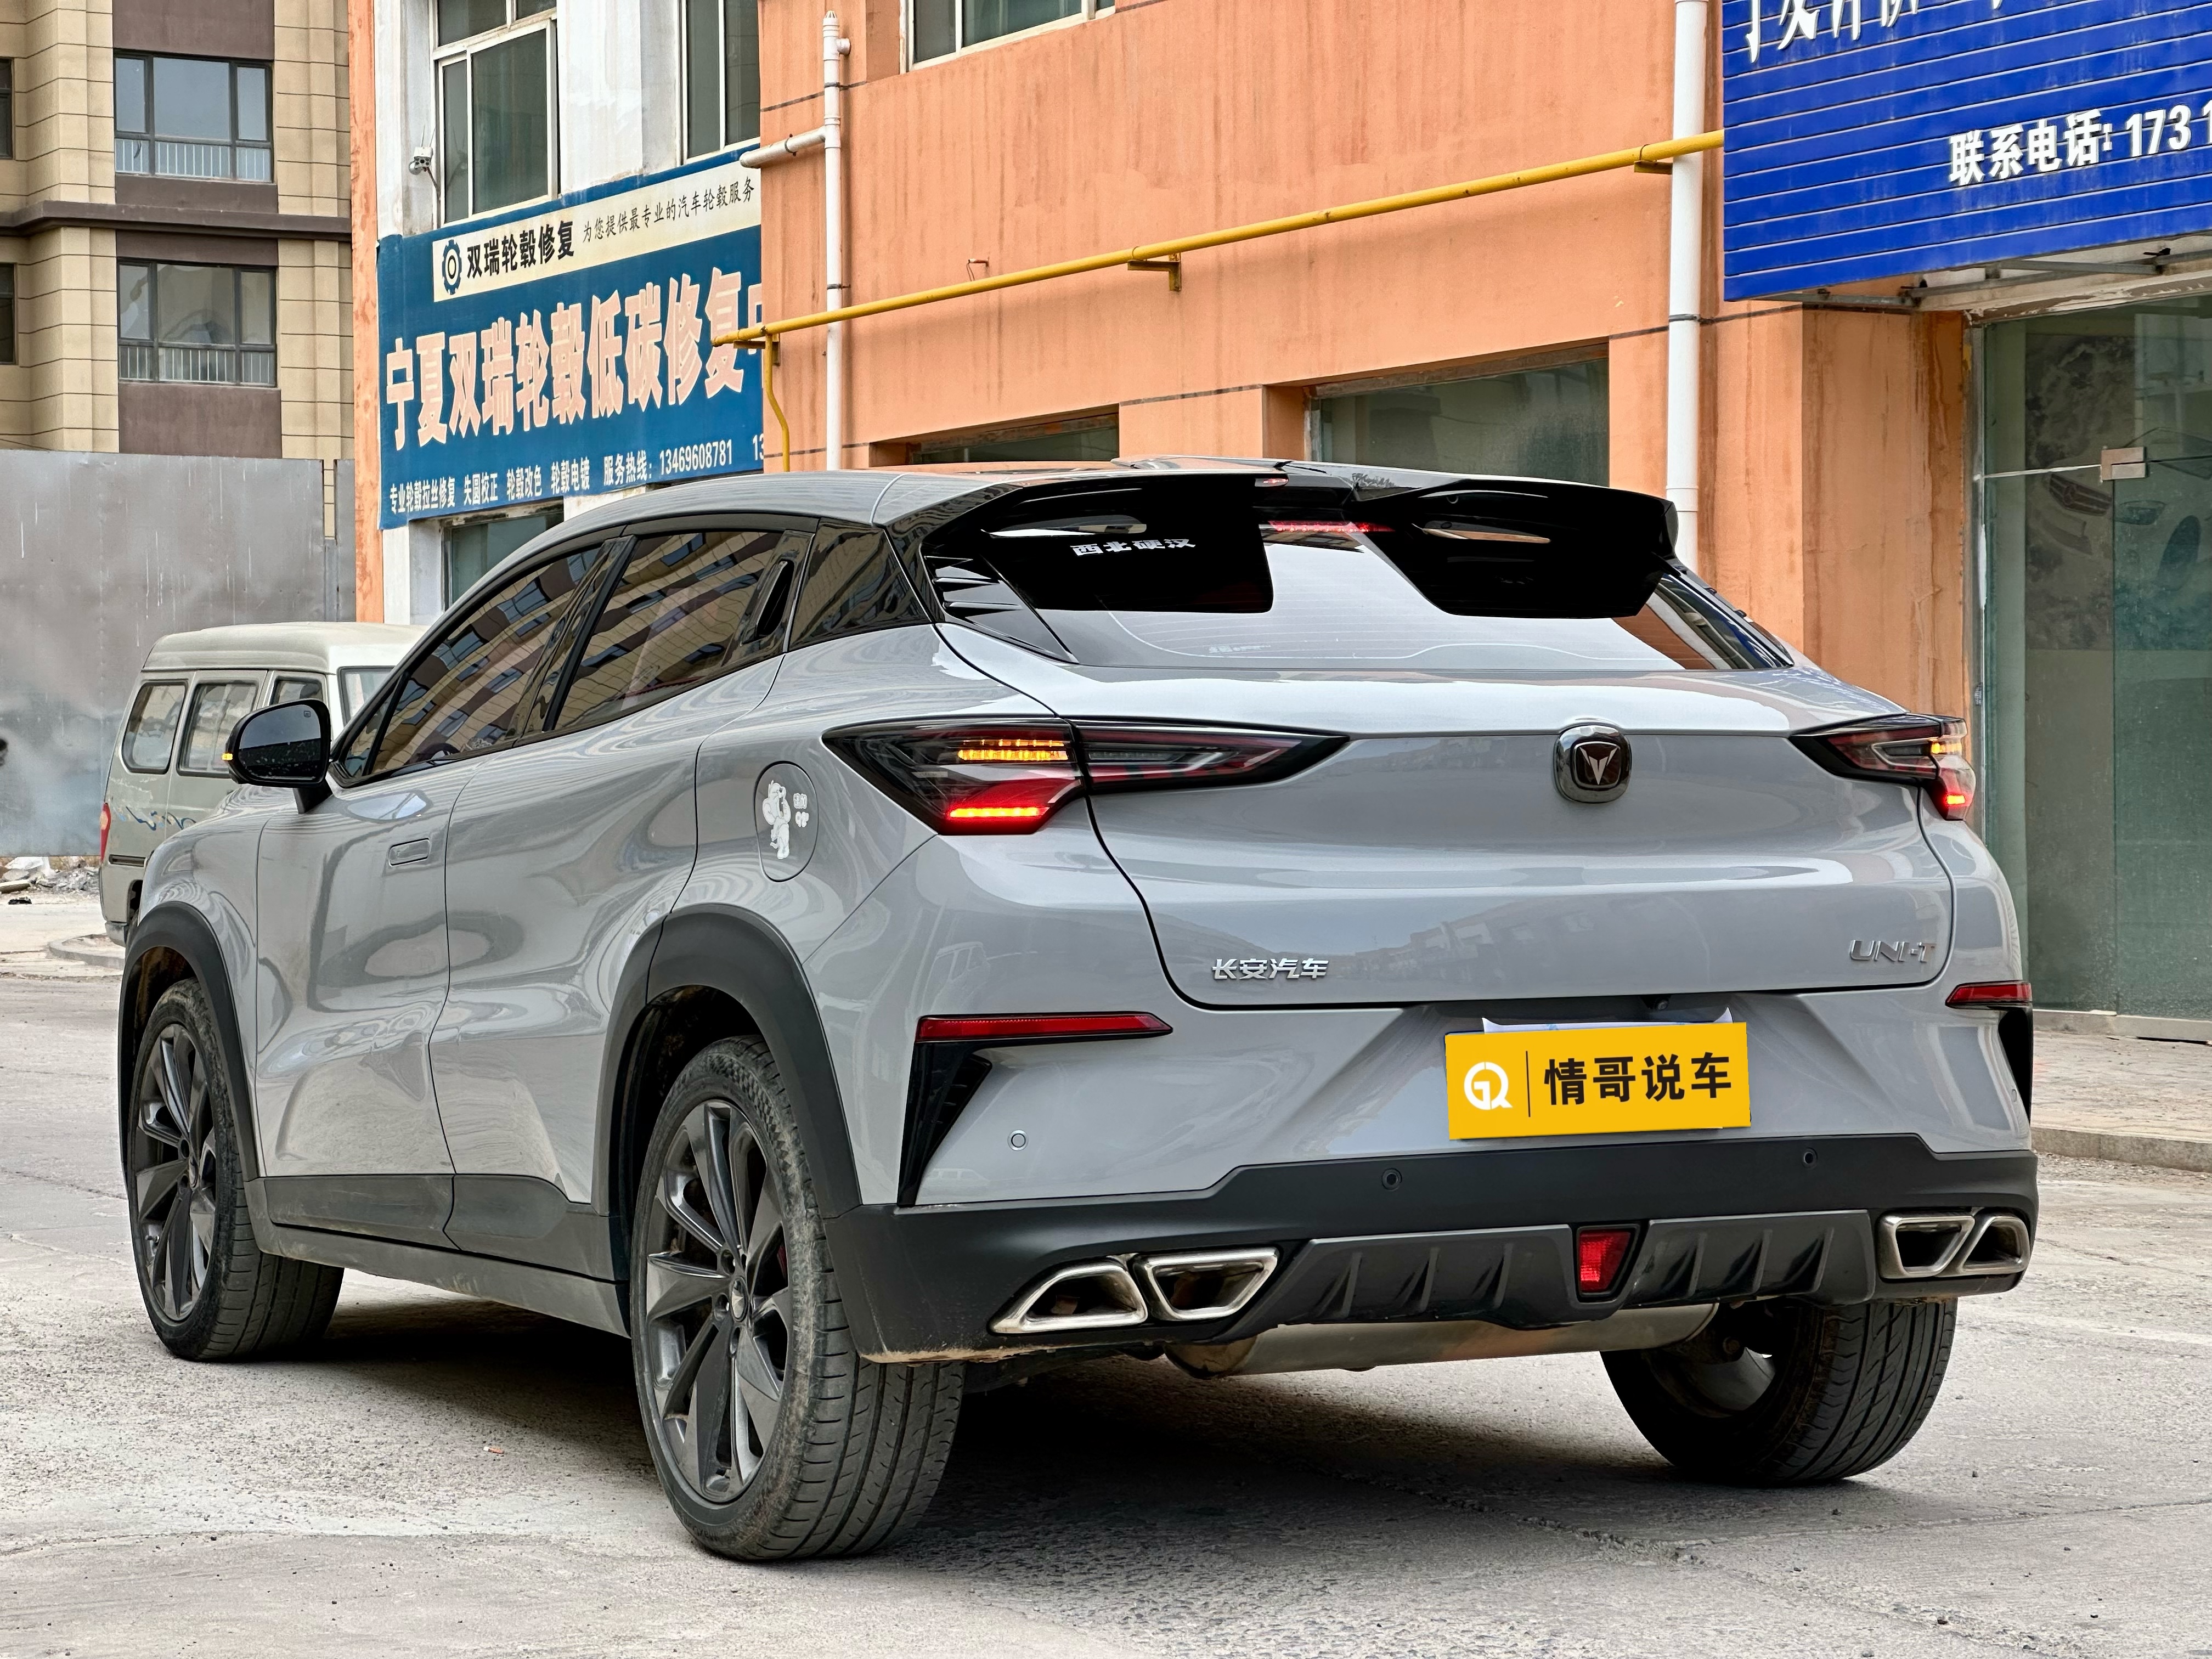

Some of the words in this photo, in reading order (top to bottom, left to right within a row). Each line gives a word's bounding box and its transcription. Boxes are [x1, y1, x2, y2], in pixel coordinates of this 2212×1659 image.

[467, 221, 574, 279] 双瑞轮毂修复
[583, 176, 755, 243] 为您提供最专业的汽车轮毂服务
[390, 476, 455, 514] 专业轮毂拉丝修复
[464, 472, 499, 506] 失圆校正
[506, 465, 542, 501] 轮毂改色
[550, 456, 590, 494] 轮毂电镀
[659, 439, 732, 475] 13469608781
[1070, 539, 1196, 556] 西北硬汉
[1849, 940, 1936, 962] UNI-T
[1211, 958, 1329, 980] 长安汽车
